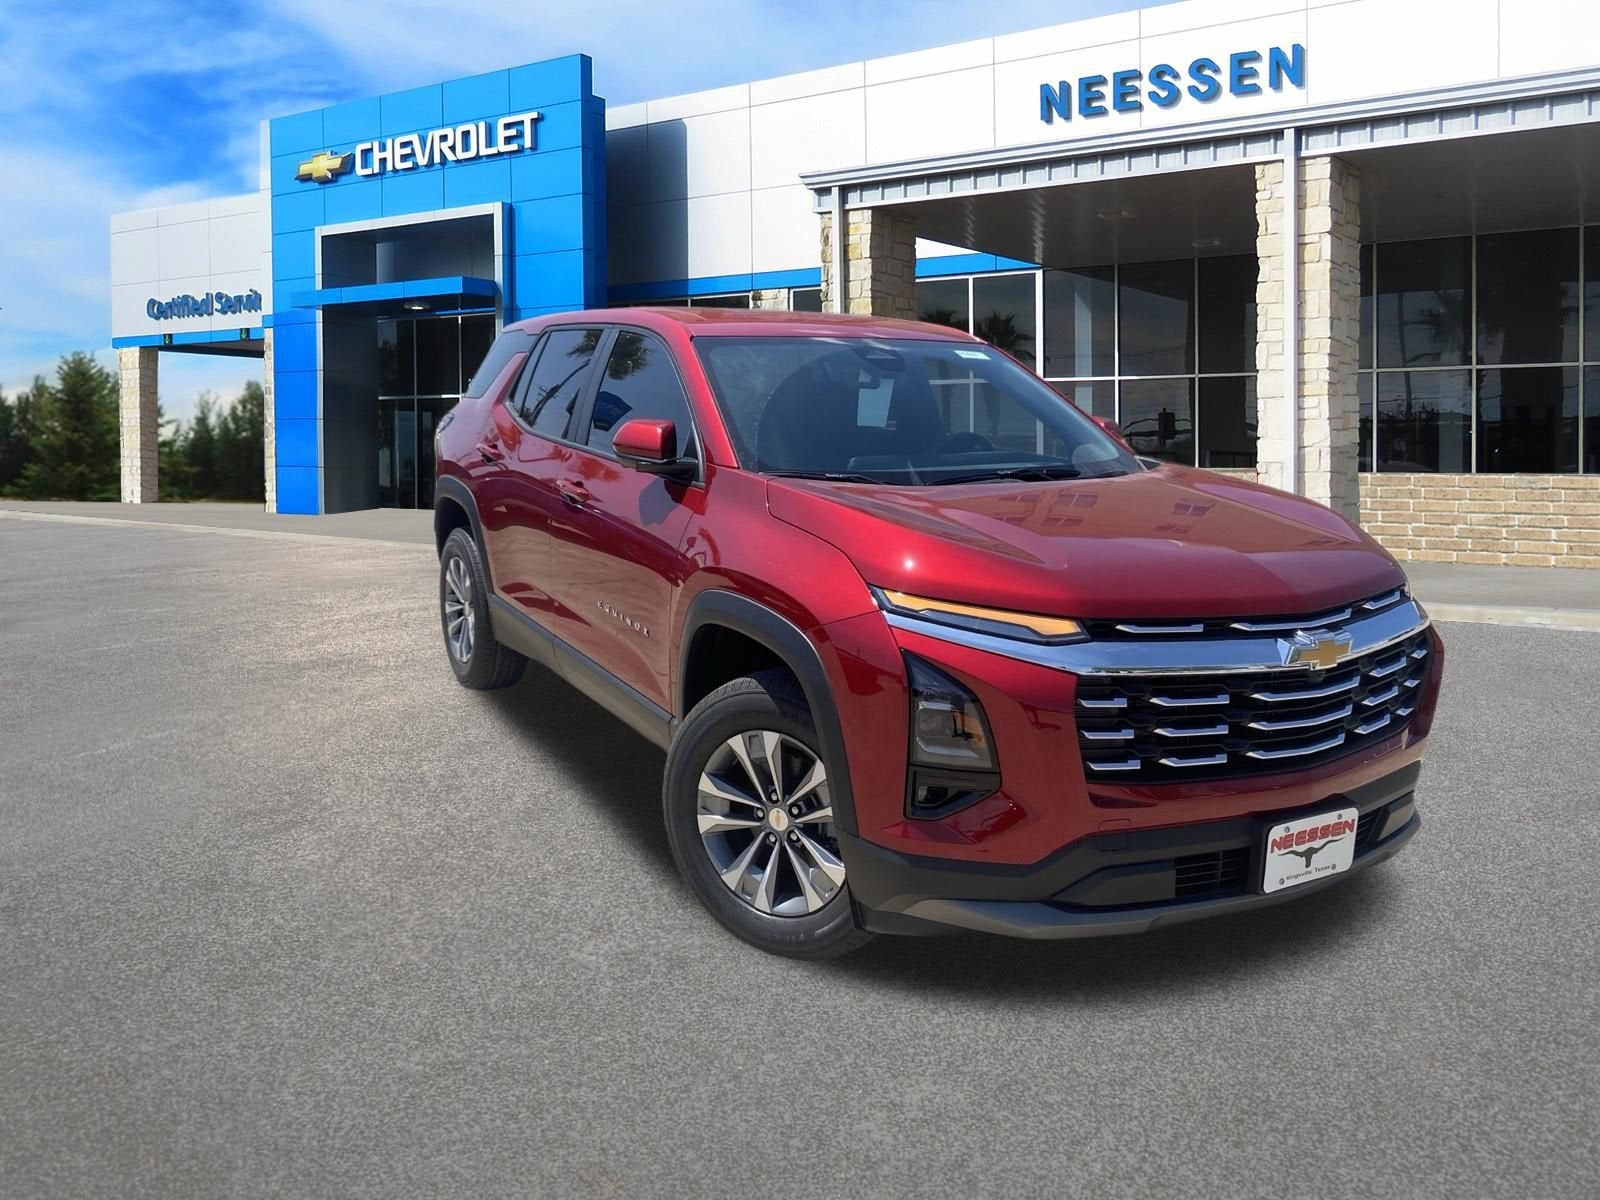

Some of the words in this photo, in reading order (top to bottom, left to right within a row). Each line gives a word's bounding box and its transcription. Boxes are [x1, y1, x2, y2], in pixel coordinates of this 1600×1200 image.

[1040, 43, 1305, 123] NEESSEN
[354, 110, 544, 177] CHEVROLET
[147, 291, 214, 321] Certified
[597, 600, 650, 637] EQUINOX
[1270, 818, 1356, 854] NEESSEN
